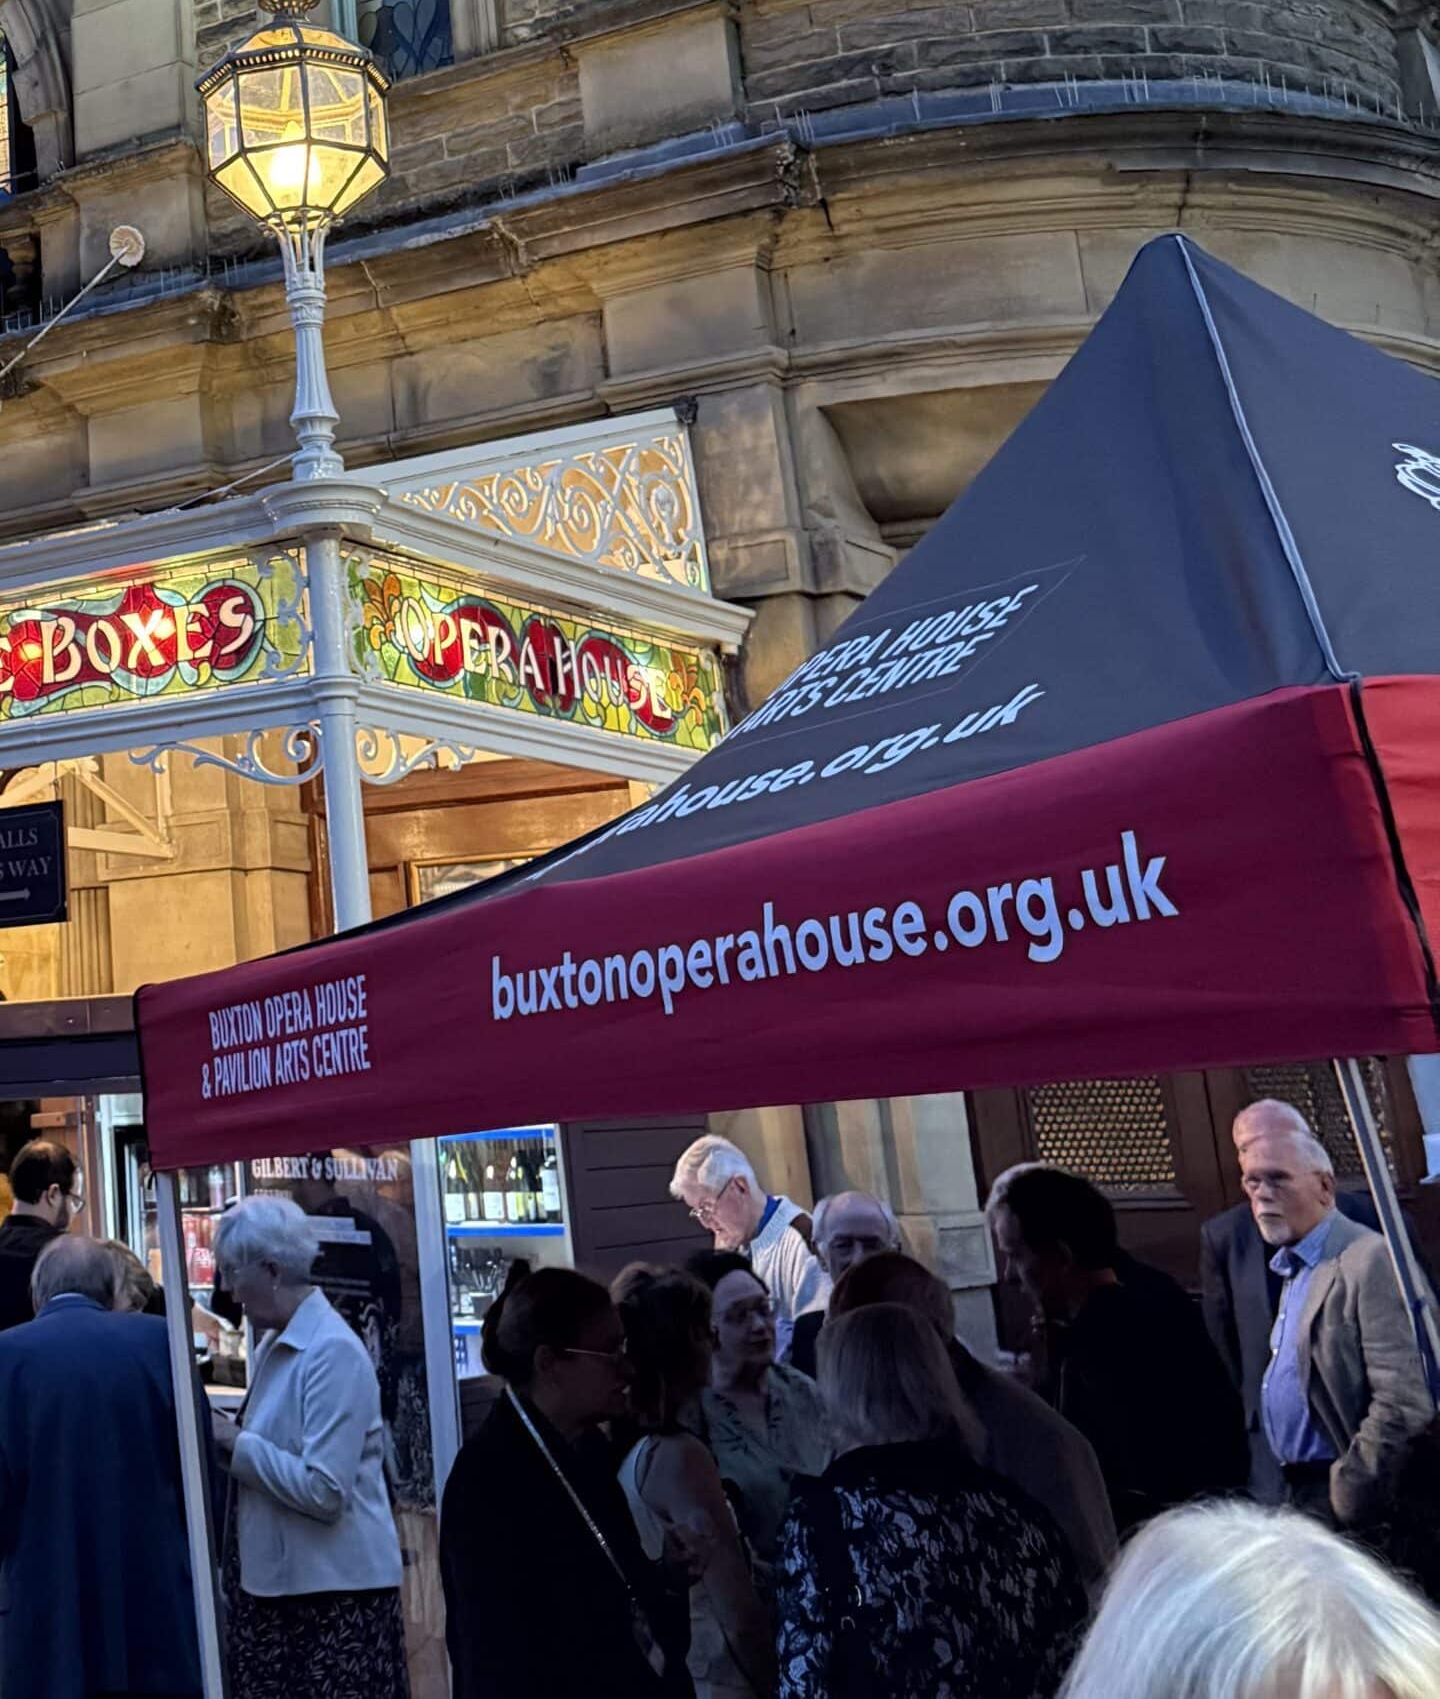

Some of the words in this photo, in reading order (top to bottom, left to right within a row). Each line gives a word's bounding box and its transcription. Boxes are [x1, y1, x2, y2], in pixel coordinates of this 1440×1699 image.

[40, 596, 254, 684] BOXES
[400, 597, 544, 691] OPERA
[553, 636, 673, 720] HOUSE
[880, 585, 1039, 660] HOUSE
[824, 632, 994, 707] CENTRE
[8, 856, 52, 877] WAY
[491, 830, 1179, 1020] buxtonoperahouse.org.uk
[208, 1000, 264, 1051] BUXTON
[264, 988, 314, 1039] OPERA
[314, 974, 368, 1027] HOUSE
[202, 1063, 211, 1099] &
[213, 1046, 273, 1097] PAVILION
[275, 1038, 310, 1086] ARTS
[312, 1025, 372, 1079] CENTRE
[251, 1156, 310, 1179] GILBERT
[311, 1158, 323, 1181] &
[325, 1156, 398, 1182] SULLIVAN
